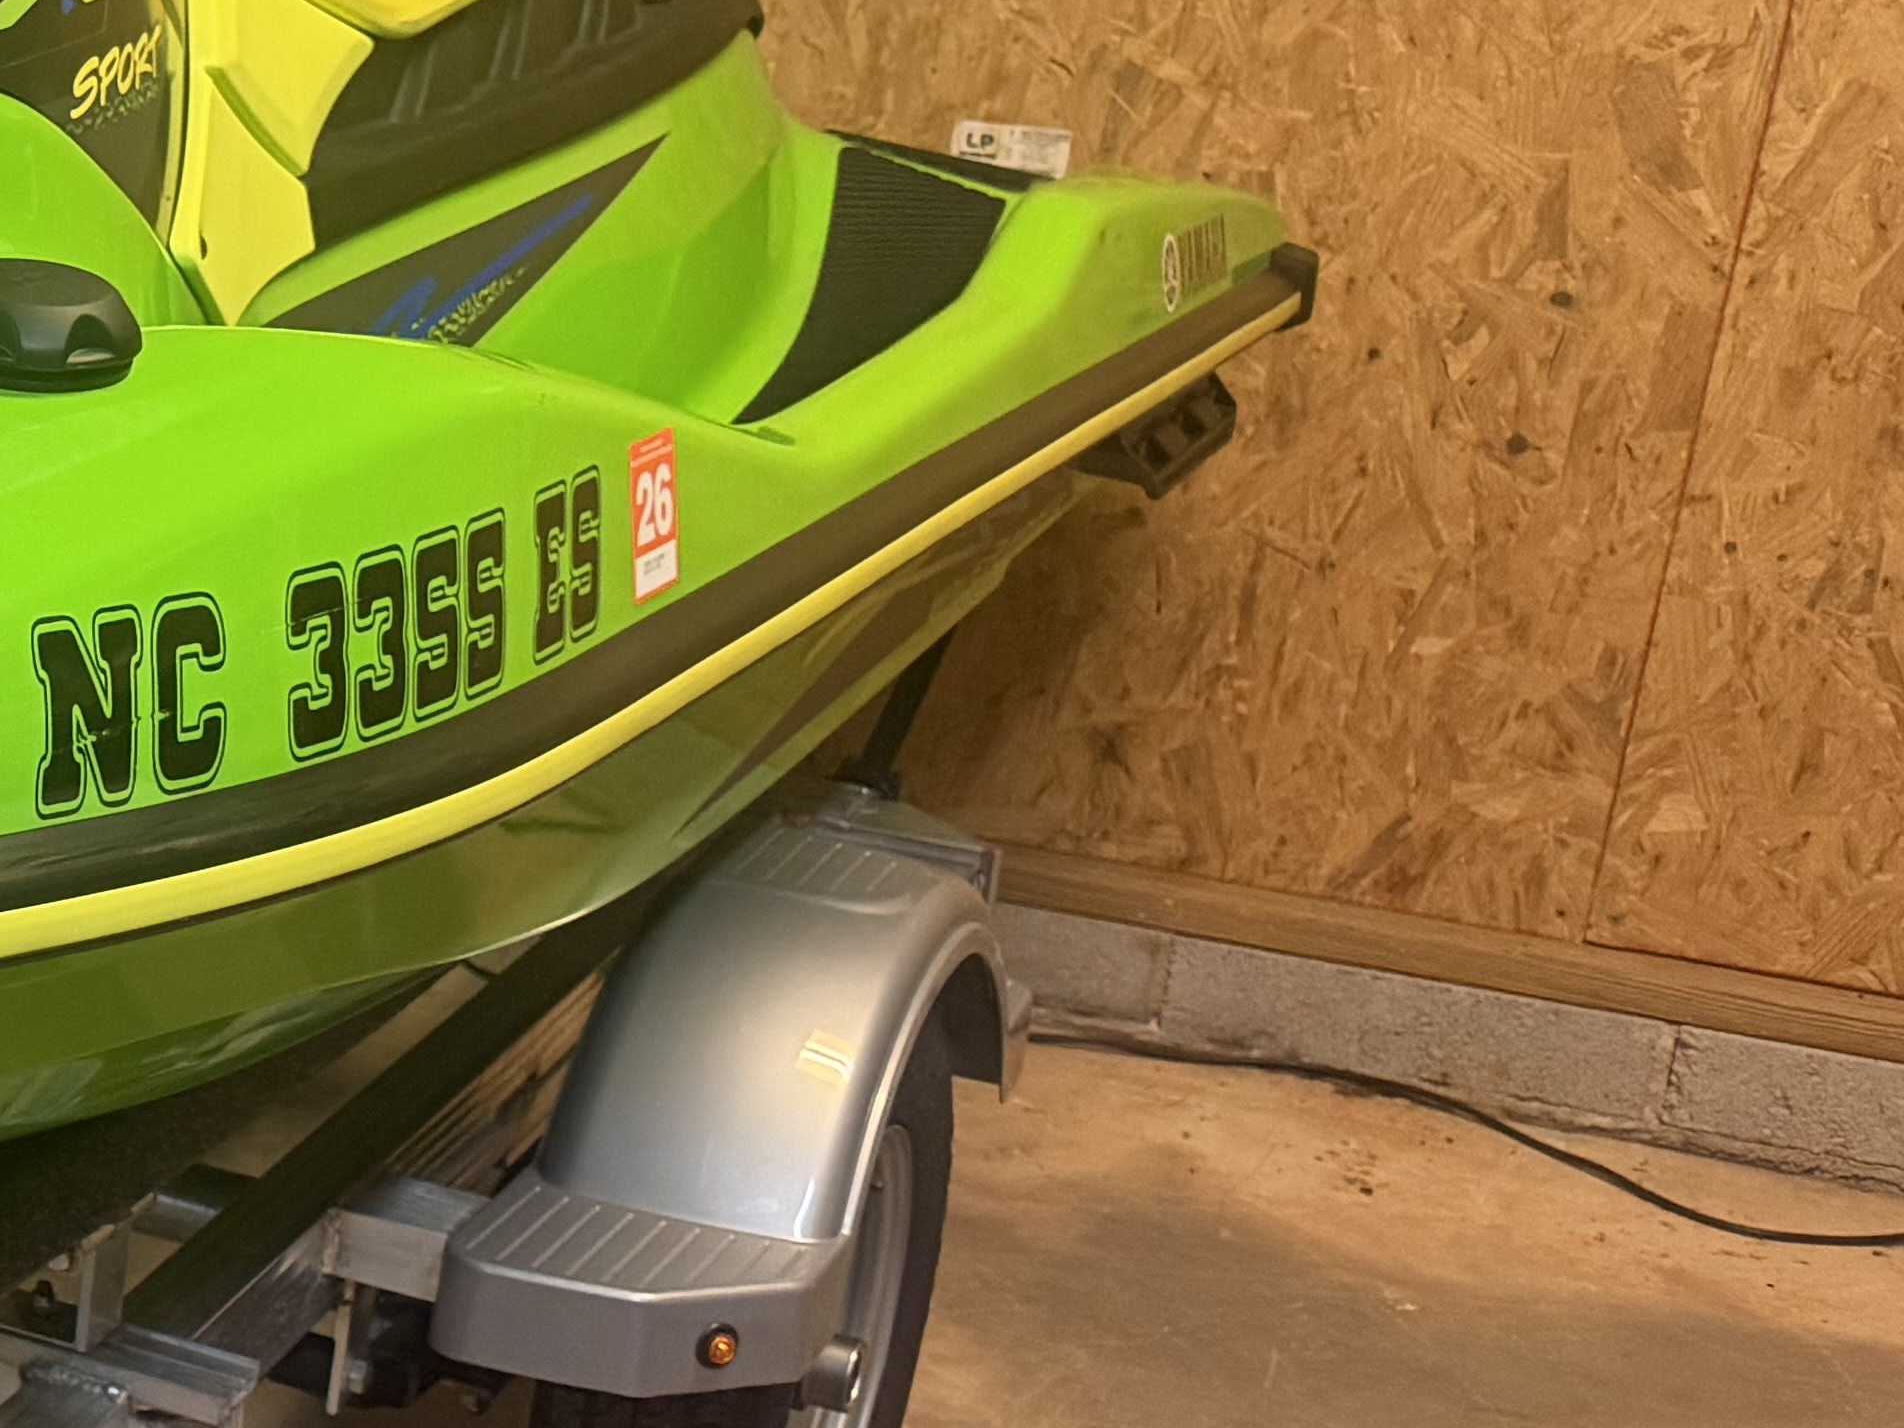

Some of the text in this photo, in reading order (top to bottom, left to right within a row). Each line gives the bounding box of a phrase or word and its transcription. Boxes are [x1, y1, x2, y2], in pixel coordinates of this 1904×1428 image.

[70, 24, 162, 120] SPORT
[635, 462, 674, 548] 26
[31, 590, 226, 821] NC
[533, 464, 602, 666] ES
